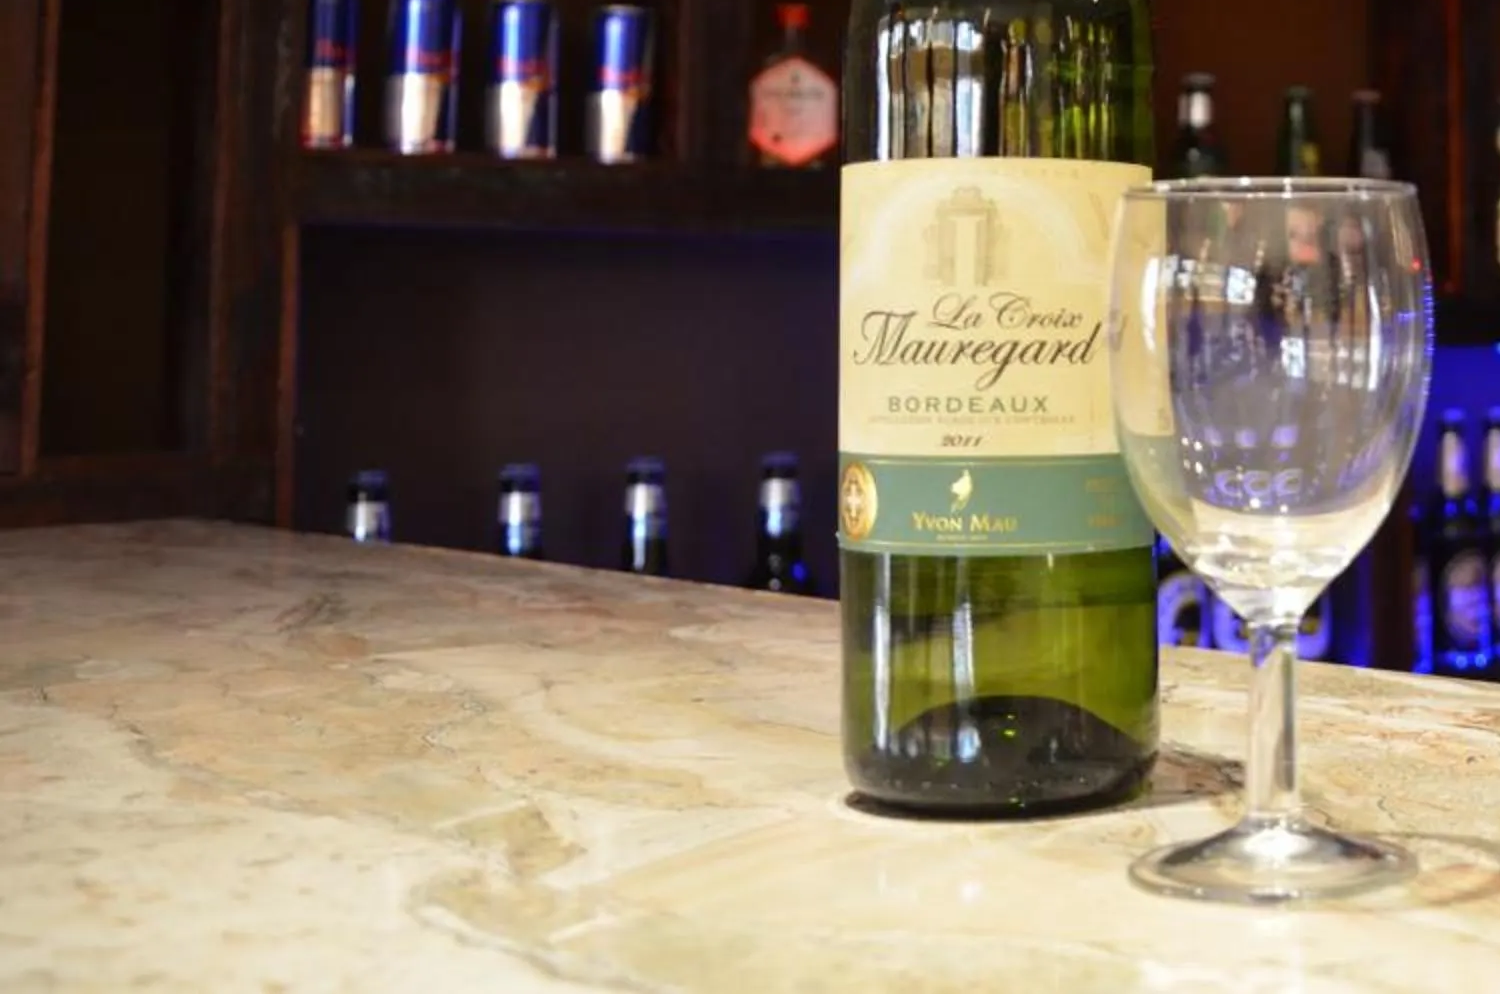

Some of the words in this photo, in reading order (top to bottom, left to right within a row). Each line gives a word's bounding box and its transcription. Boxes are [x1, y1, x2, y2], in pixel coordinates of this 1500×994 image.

[928, 292, 983, 331] La
[988, 291, 1084, 330] Croix
[853, 309, 1104, 392] Mauregard
[888, 395, 1049, 414] BORDEAUX
[940, 433, 984, 447] 2011
